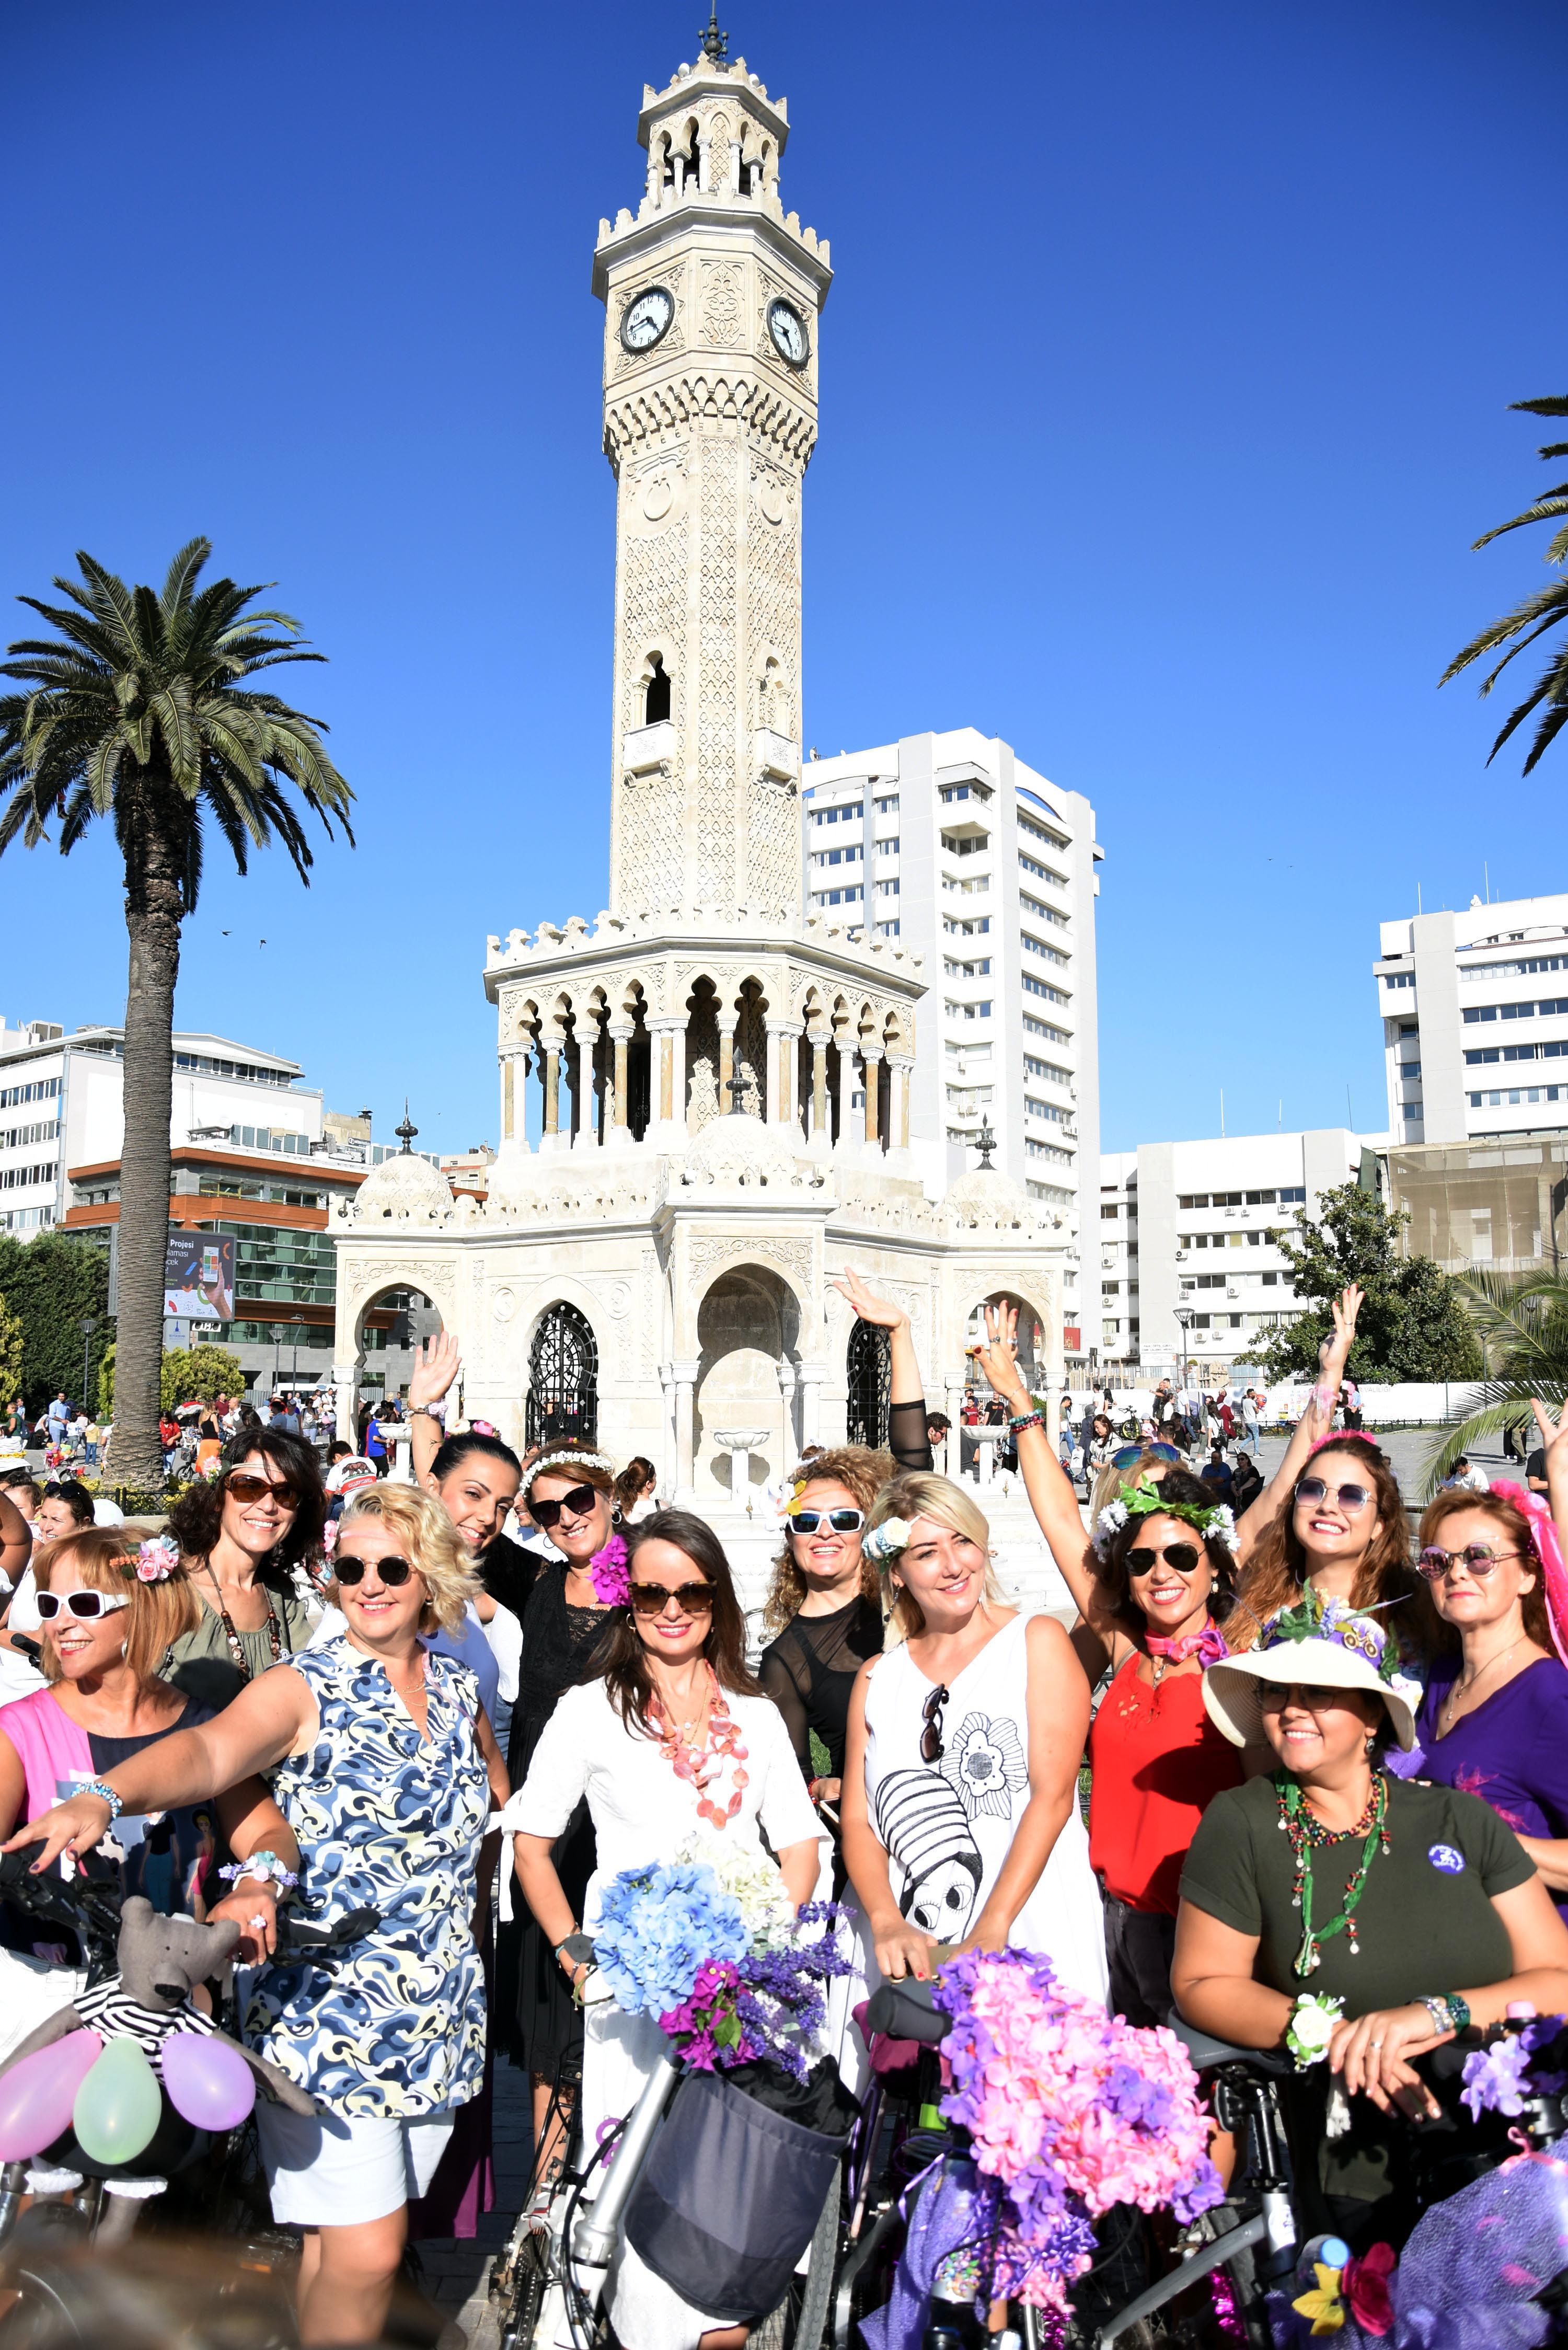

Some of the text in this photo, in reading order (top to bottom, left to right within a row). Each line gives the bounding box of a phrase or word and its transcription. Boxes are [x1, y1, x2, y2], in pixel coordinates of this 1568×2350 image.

[647, 294, 653, 304] 12
[640, 302, 645, 310] 11
[633, 313, 640, 321] 10
[782, 307, 787, 318] 12
[794, 327, 798, 336] 2
[170, 1239, 194, 1249] Projesi
